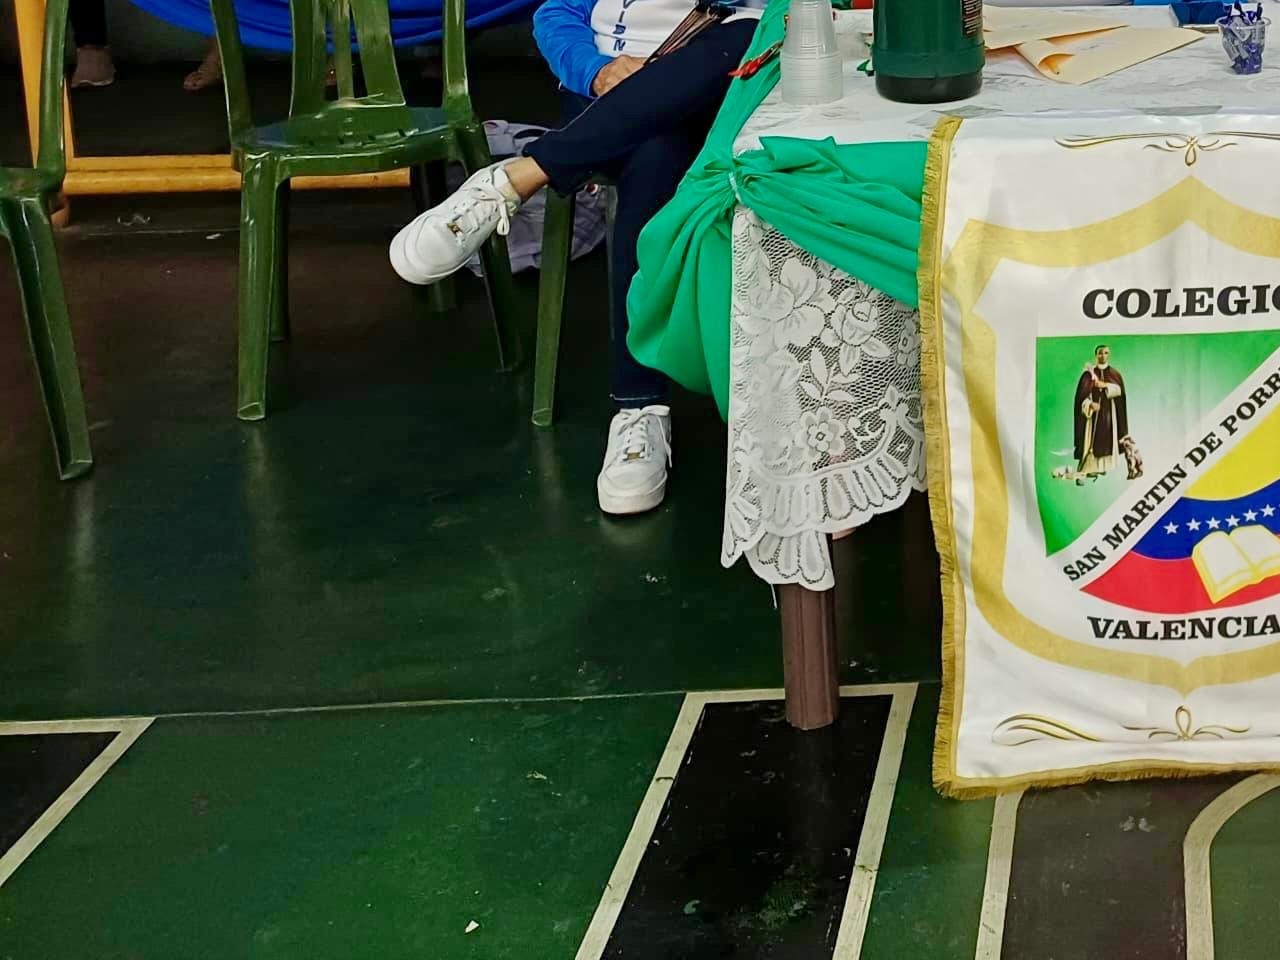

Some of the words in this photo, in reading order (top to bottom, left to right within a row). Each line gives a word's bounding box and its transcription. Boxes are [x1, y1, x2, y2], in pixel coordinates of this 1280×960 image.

[1063, 546, 1107, 582] SAN
[1102, 463, 1188, 550] MARTIN
[1184, 431, 1224, 467] DE
